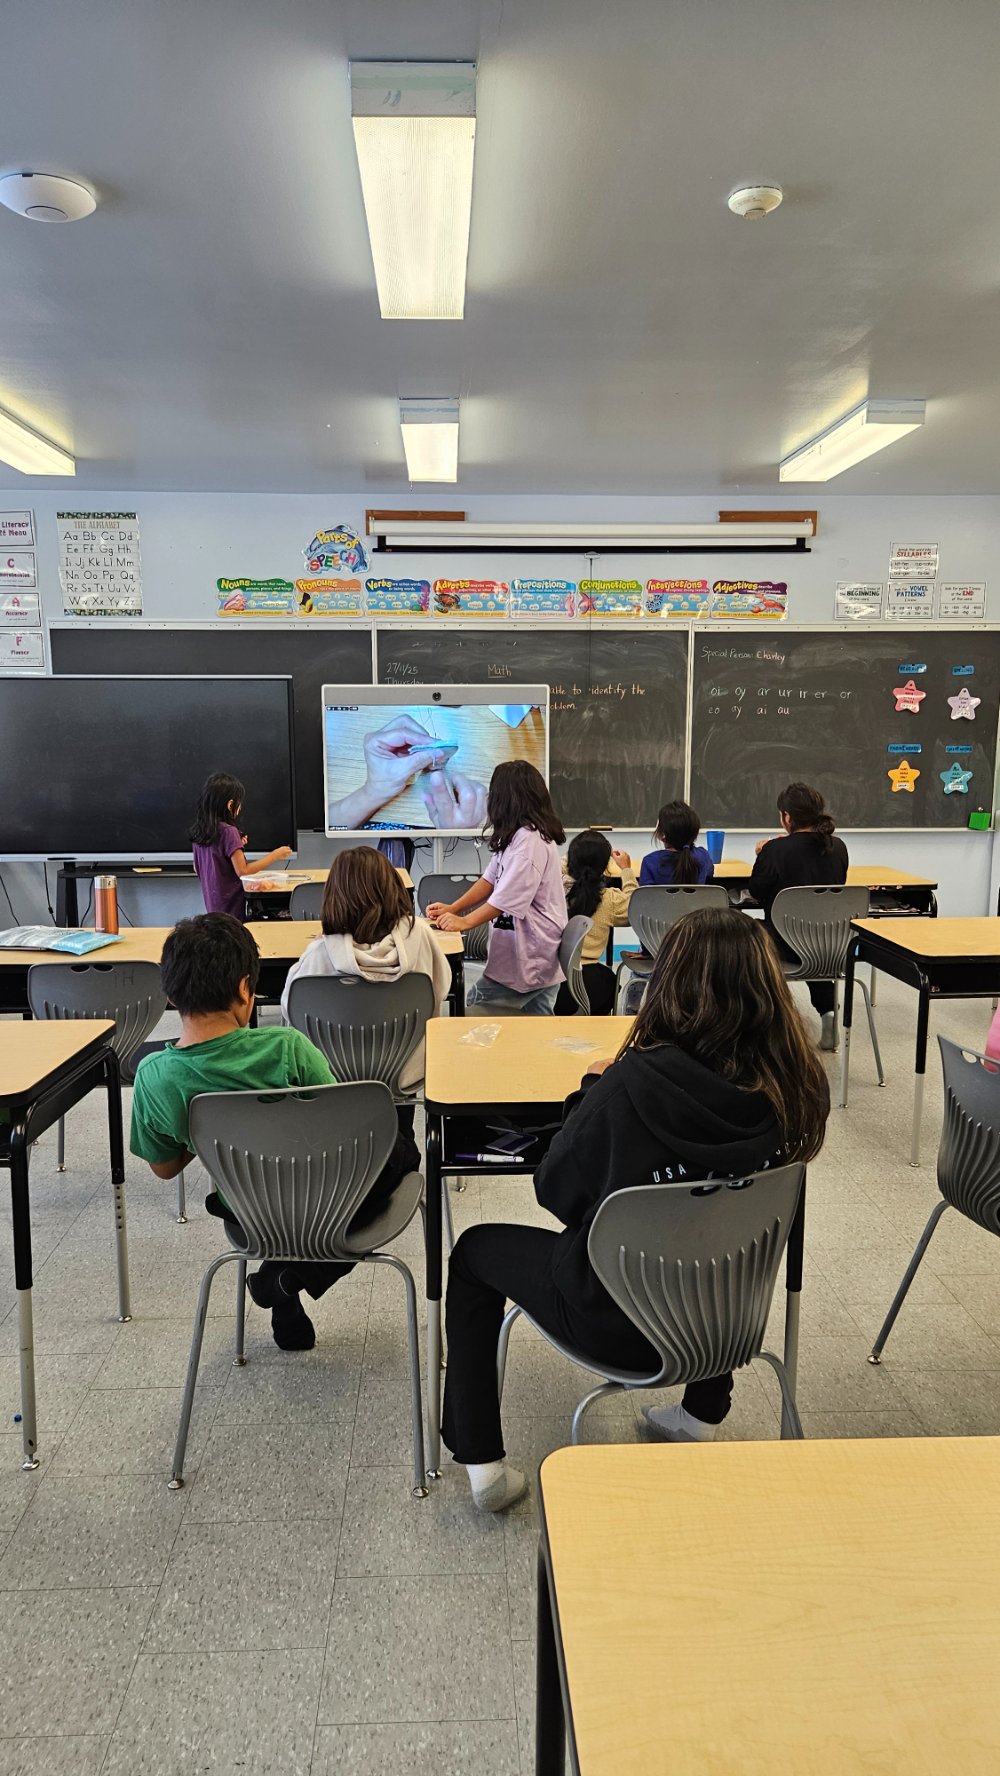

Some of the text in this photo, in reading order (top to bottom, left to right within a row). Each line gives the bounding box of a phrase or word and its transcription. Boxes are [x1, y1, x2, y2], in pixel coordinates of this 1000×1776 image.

[64, 532, 133, 540] Aa Bb Cc Dd
[316, 530, 348, 544] Parts
[345, 537, 360, 550] of
[66, 544, 131, 556] Ee Ff Gg Hh
[7, 559, 14, 568] C
[65, 557, 134, 569] Ii Jj Kk Ll Mm
[310, 550, 356, 571] SPEECH
[66, 571, 135, 582] Nn Oo Pp Qq
[67, 583, 135, 592] Rr Ss Tt Uu Vv
[221, 579, 251, 589] Nouns
[297, 580, 338, 591] Pronouns
[367, 580, 392, 590] Verbs
[436, 581, 470, 590] Adverbs
[514, 580, 566, 589] Prepositions
[581, 581, 637, 589] Conjunctions
[648, 580, 702, 592] Interjections
[714, 581, 758, 593] Adjectives
[12, 597, 20, 607] A
[92, 596, 104, 605] Xx
[108, 596, 120, 607] Yy
[124, 596, 134, 605] Zz
[16, 636, 22, 645] F
[701, 646, 727, 662] Special
[488, 664, 511, 678] Math
[550, 683, 646, 701] able to identify the
[757, 688, 771, 696] ar
[779, 689, 793, 698] ur
[799, 688, 808, 698] ir
[757, 705, 767, 715] ai
[653, 1163, 687, 1183] USA
